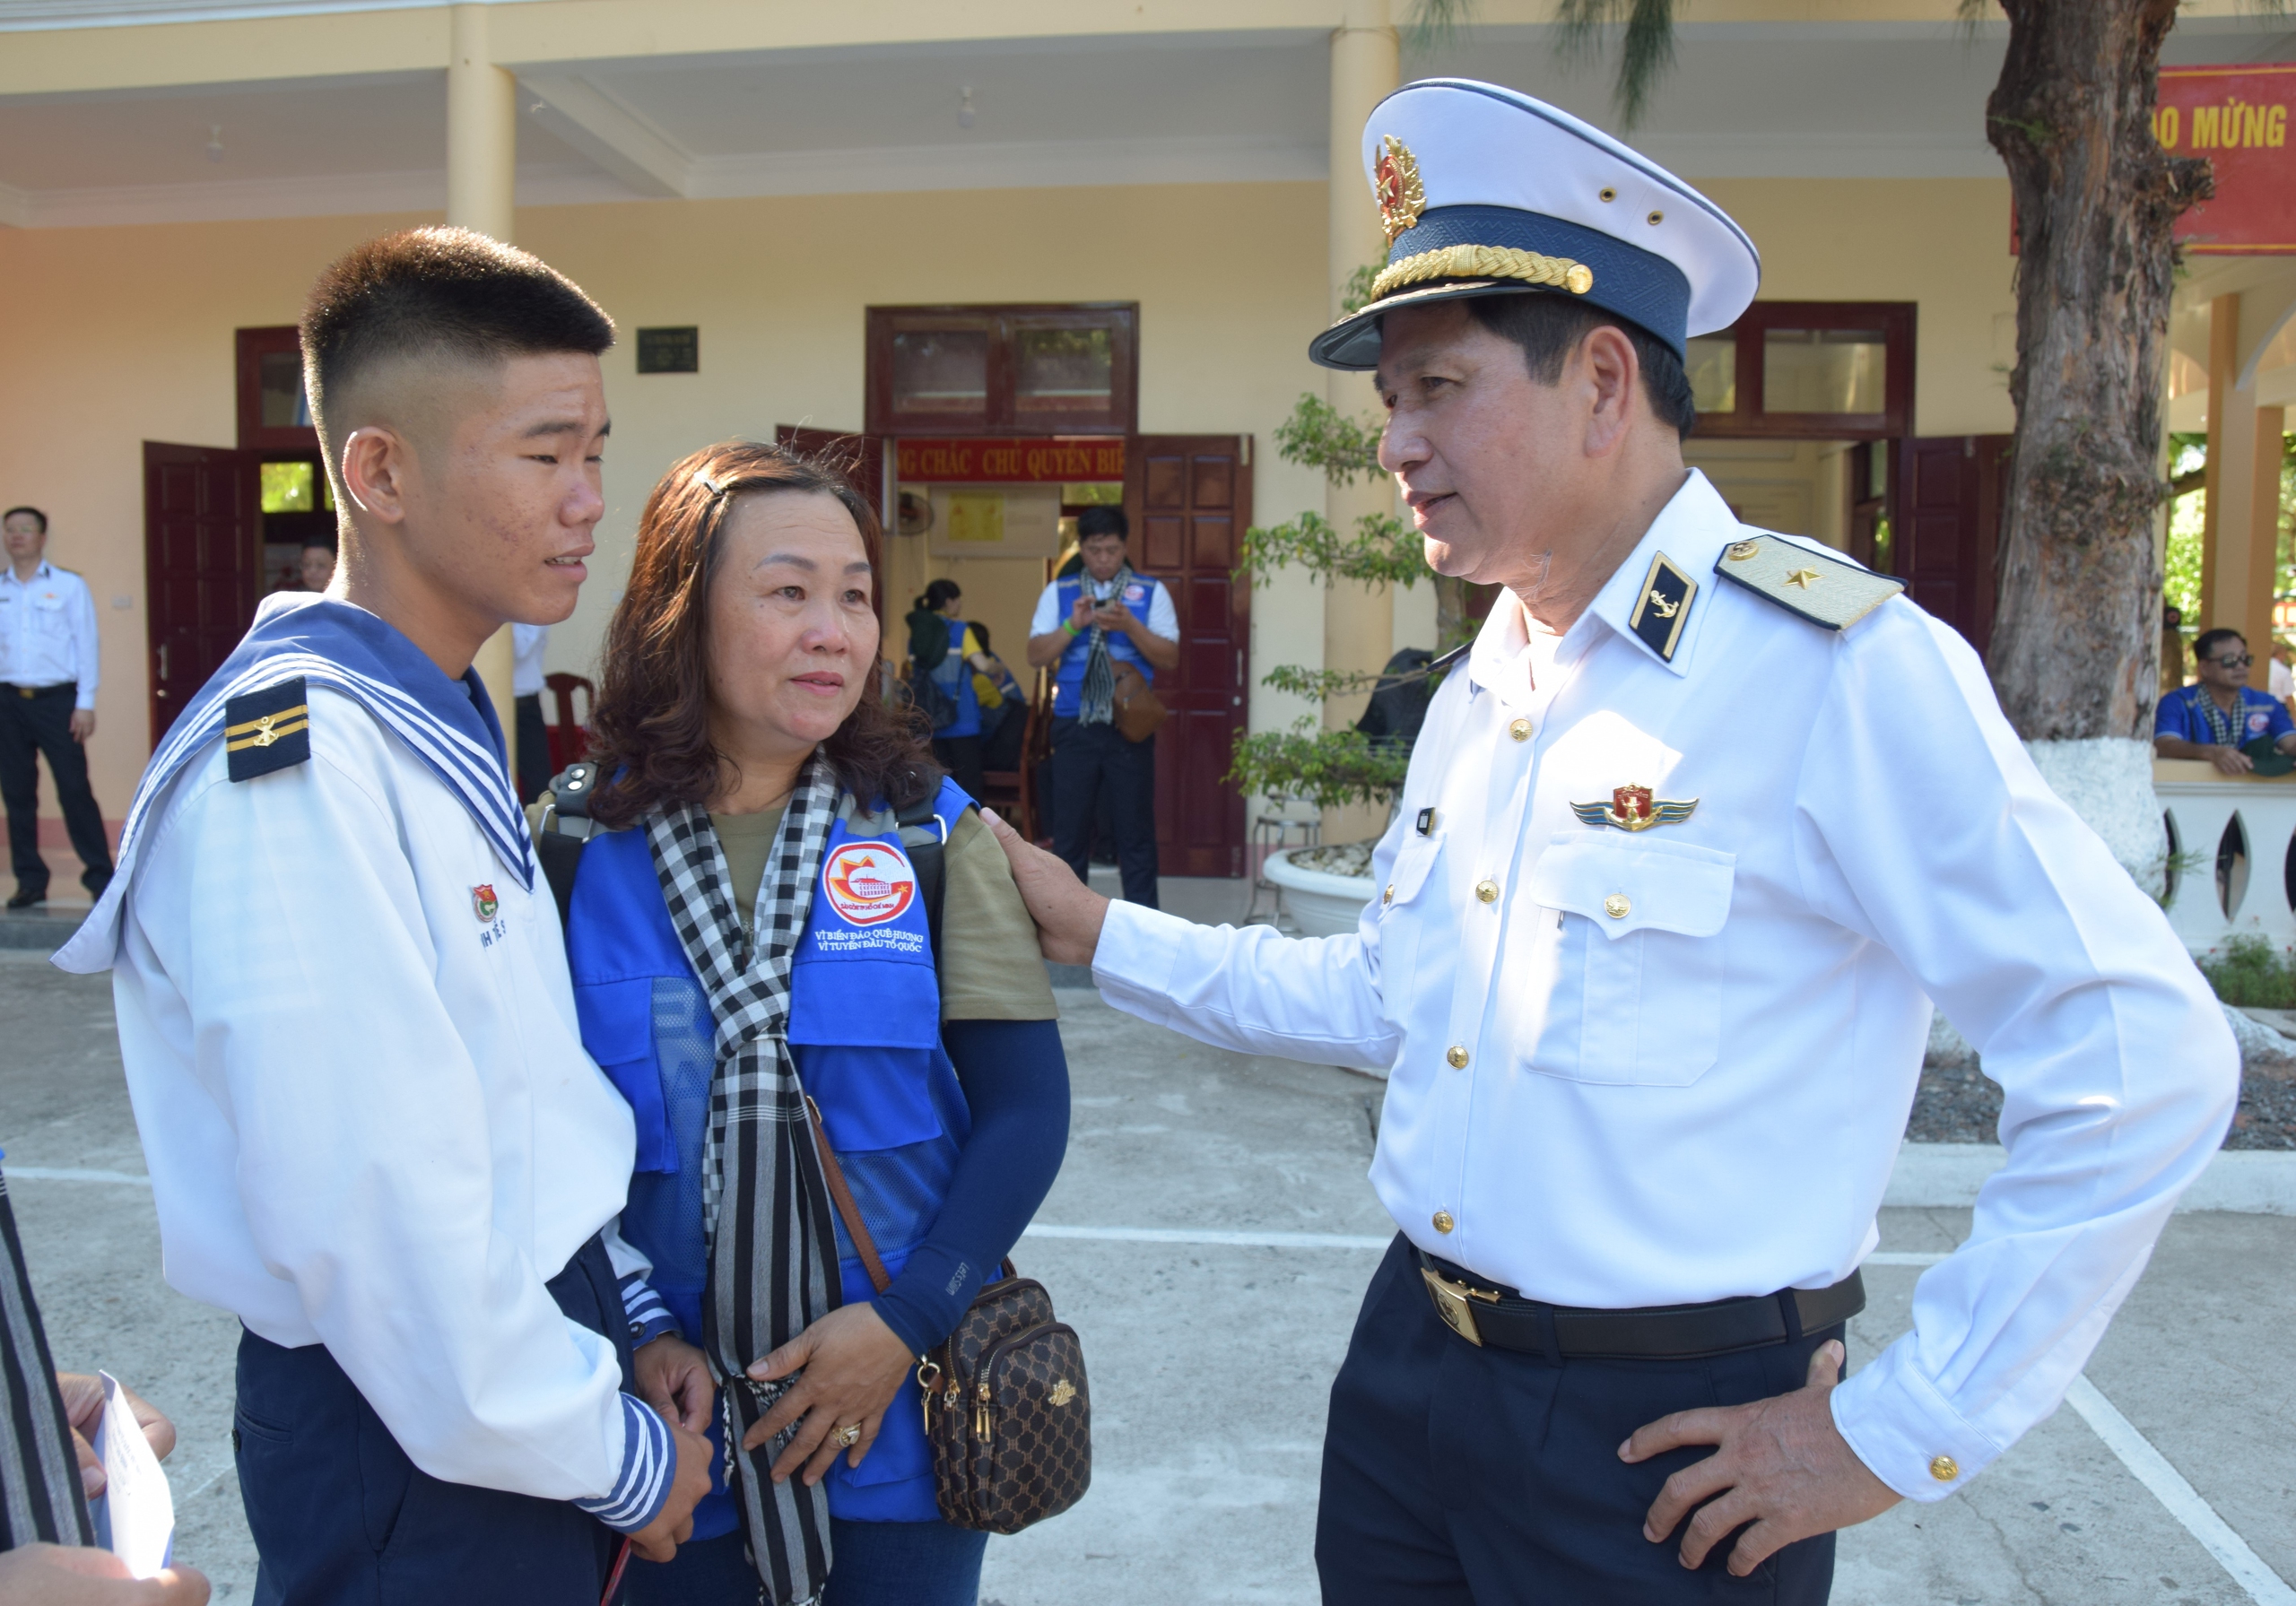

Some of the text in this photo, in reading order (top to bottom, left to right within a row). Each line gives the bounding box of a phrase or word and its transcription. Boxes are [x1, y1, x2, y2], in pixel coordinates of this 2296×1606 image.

[2192, 97, 2287, 149] MỪNG
[982, 438, 1022, 475] CHỦ
[873, 928, 892, 939] QUÊ
[897, 941, 922, 952] QUỐC
